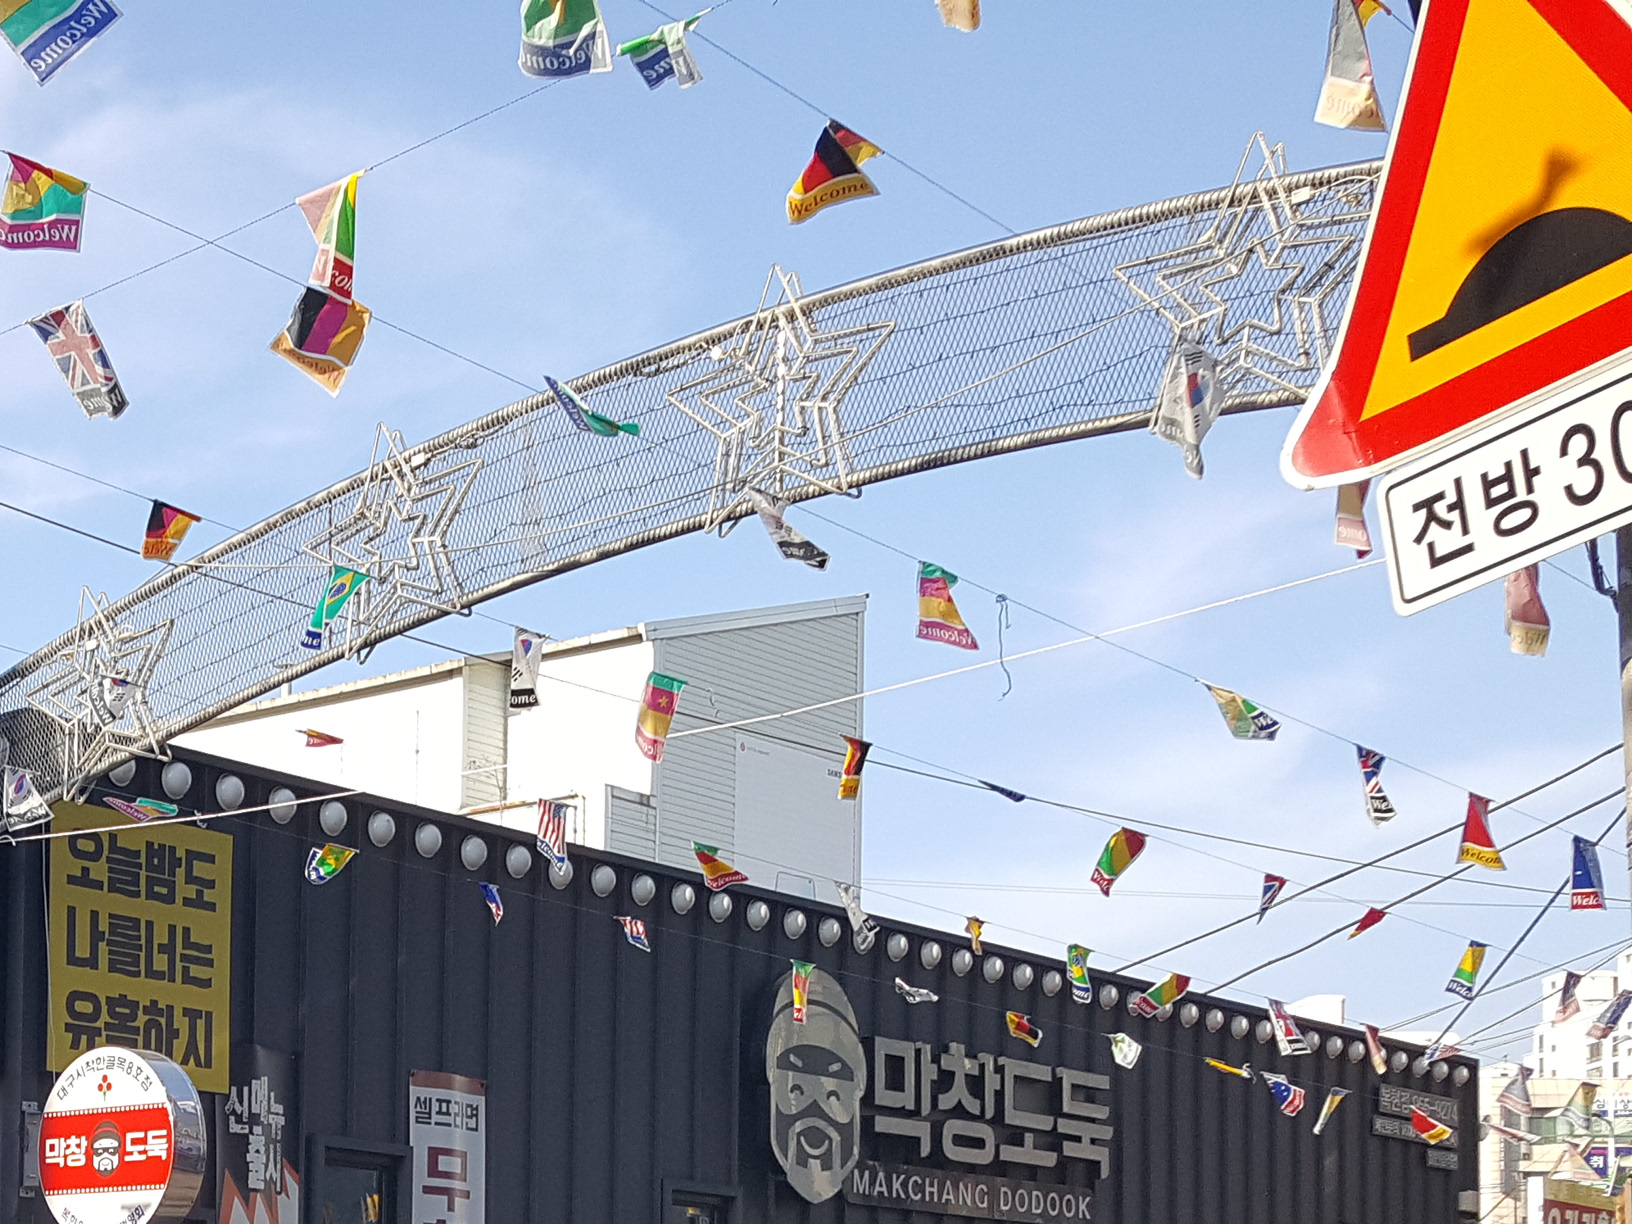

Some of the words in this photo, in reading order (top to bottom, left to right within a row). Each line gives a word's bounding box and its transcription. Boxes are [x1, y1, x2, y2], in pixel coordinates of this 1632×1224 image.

[789, 183, 869, 216] Welcome
[1412, 447, 1541, 569] 전방
[66, 826, 217, 913] 오늘밤도
[65, 904, 215, 990] 나를너는
[414, 1096, 479, 1133] 셀프라면
[874, 1035, 1114, 1180] 막창도둑
[45, 1136, 88, 1168] 막창
[124, 1130, 168, 1162] 도둑
[853, 1169, 989, 1209] MAKCHANG
[999, 1187, 1092, 1220] DODOOK
